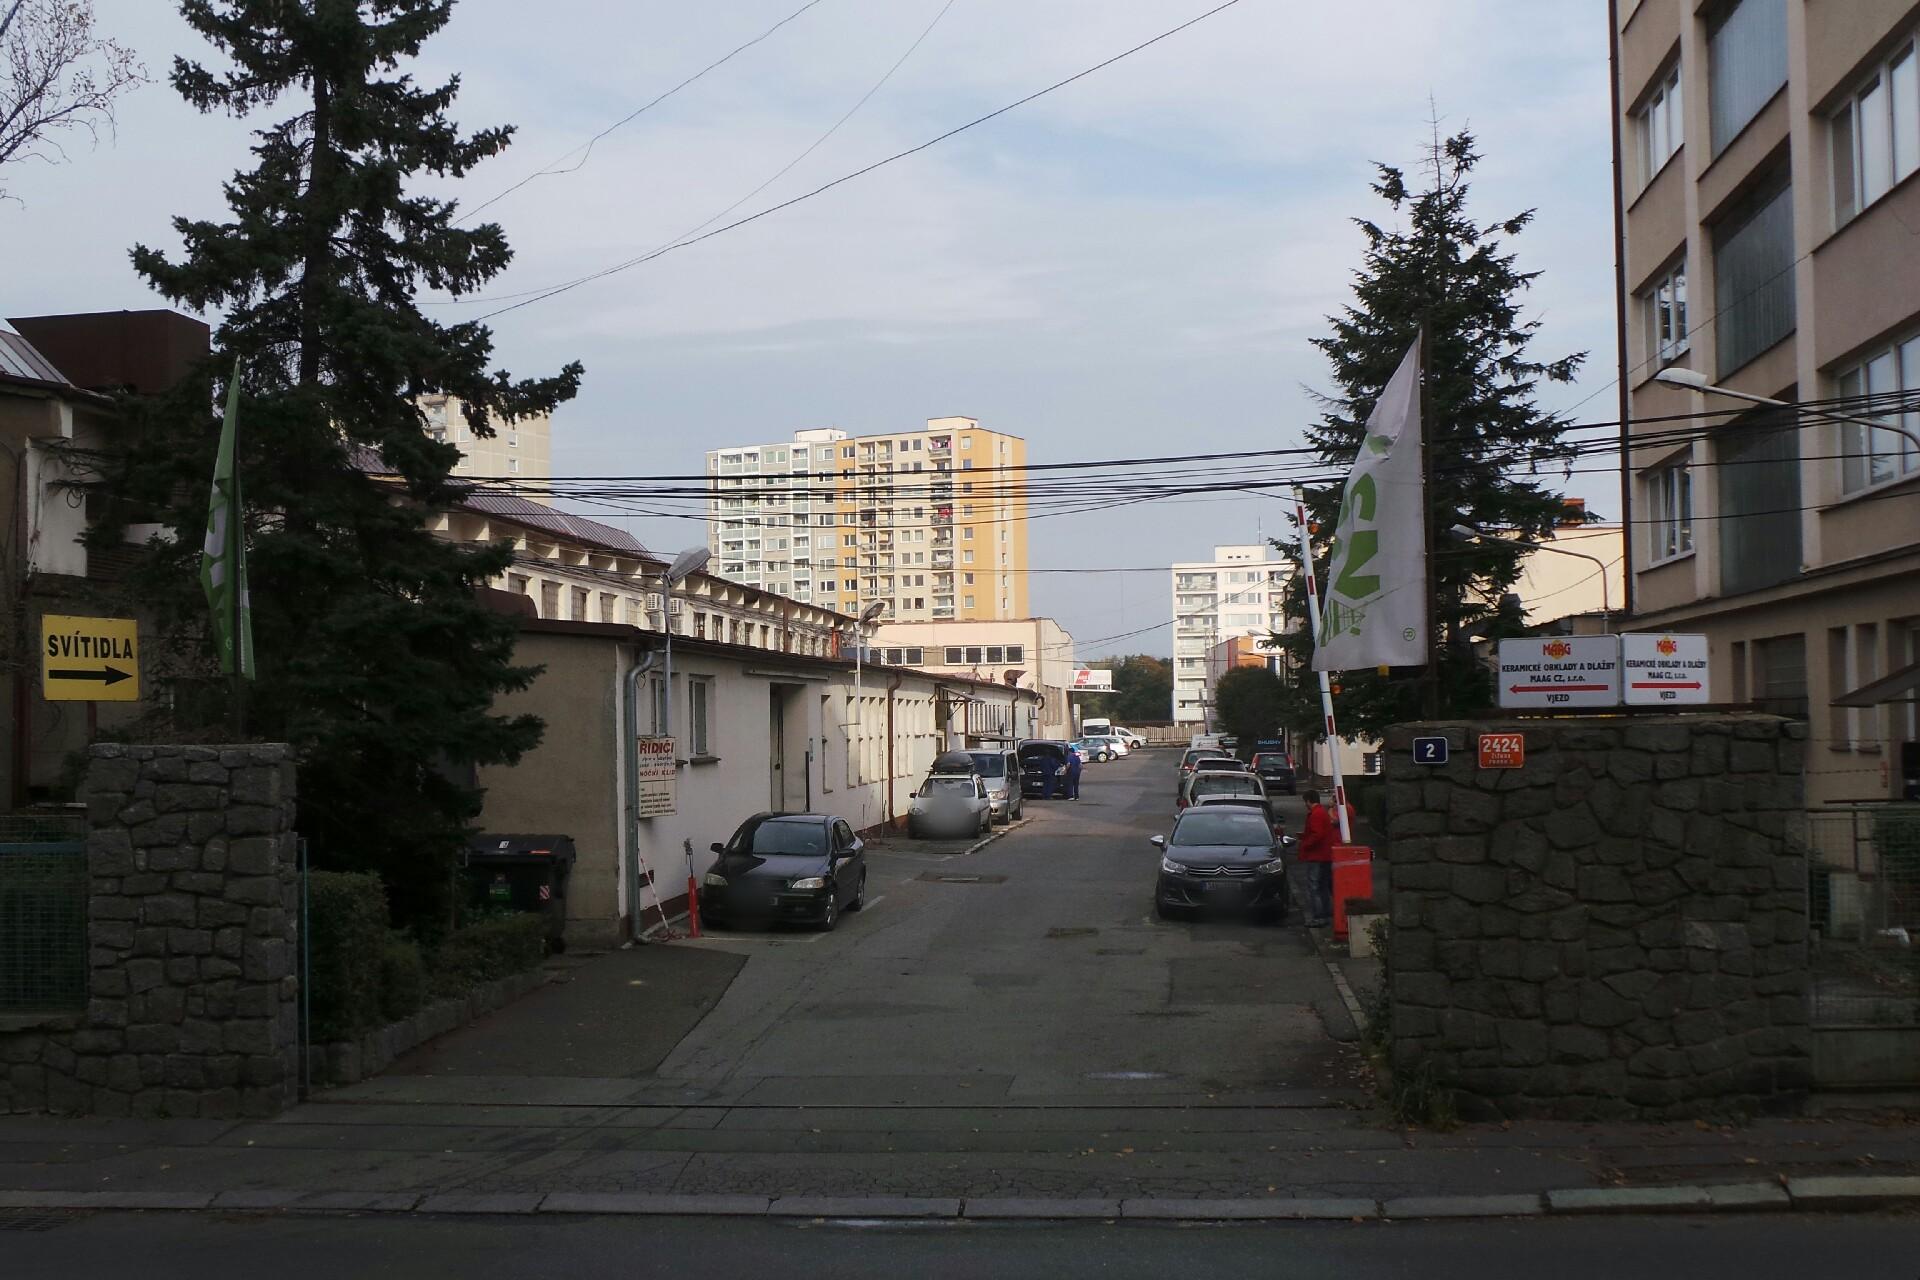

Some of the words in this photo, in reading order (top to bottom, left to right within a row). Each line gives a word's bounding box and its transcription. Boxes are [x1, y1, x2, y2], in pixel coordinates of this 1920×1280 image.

[48, 631, 133, 659] SVÍTIDLA
[1542, 643, 1571, 656] MAAG
[1656, 640, 1677, 653] MAAG
[1501, 662, 1541, 672] KERAMICKÉ
[1543, 662, 1578, 671] OBKLADY
[1579, 662, 1585, 670] A
[1587, 659, 1615, 670] DLAŽBY
[1626, 658, 1656, 668] KERAMICKÉ
[1657, 660, 1681, 668] OBKLADY
[1682, 660, 1687, 668] A
[1687, 658, 1707, 668] DLAŽBY
[1530, 674, 1552, 683] MAAG
[1648, 671, 1664, 679] MAAG
[1546, 694, 1570, 704] VJEZD
[1659, 691, 1676, 701] VJEZD
[1425, 743, 1435, 758] 2
[1482, 738, 1520, 753] 2424
